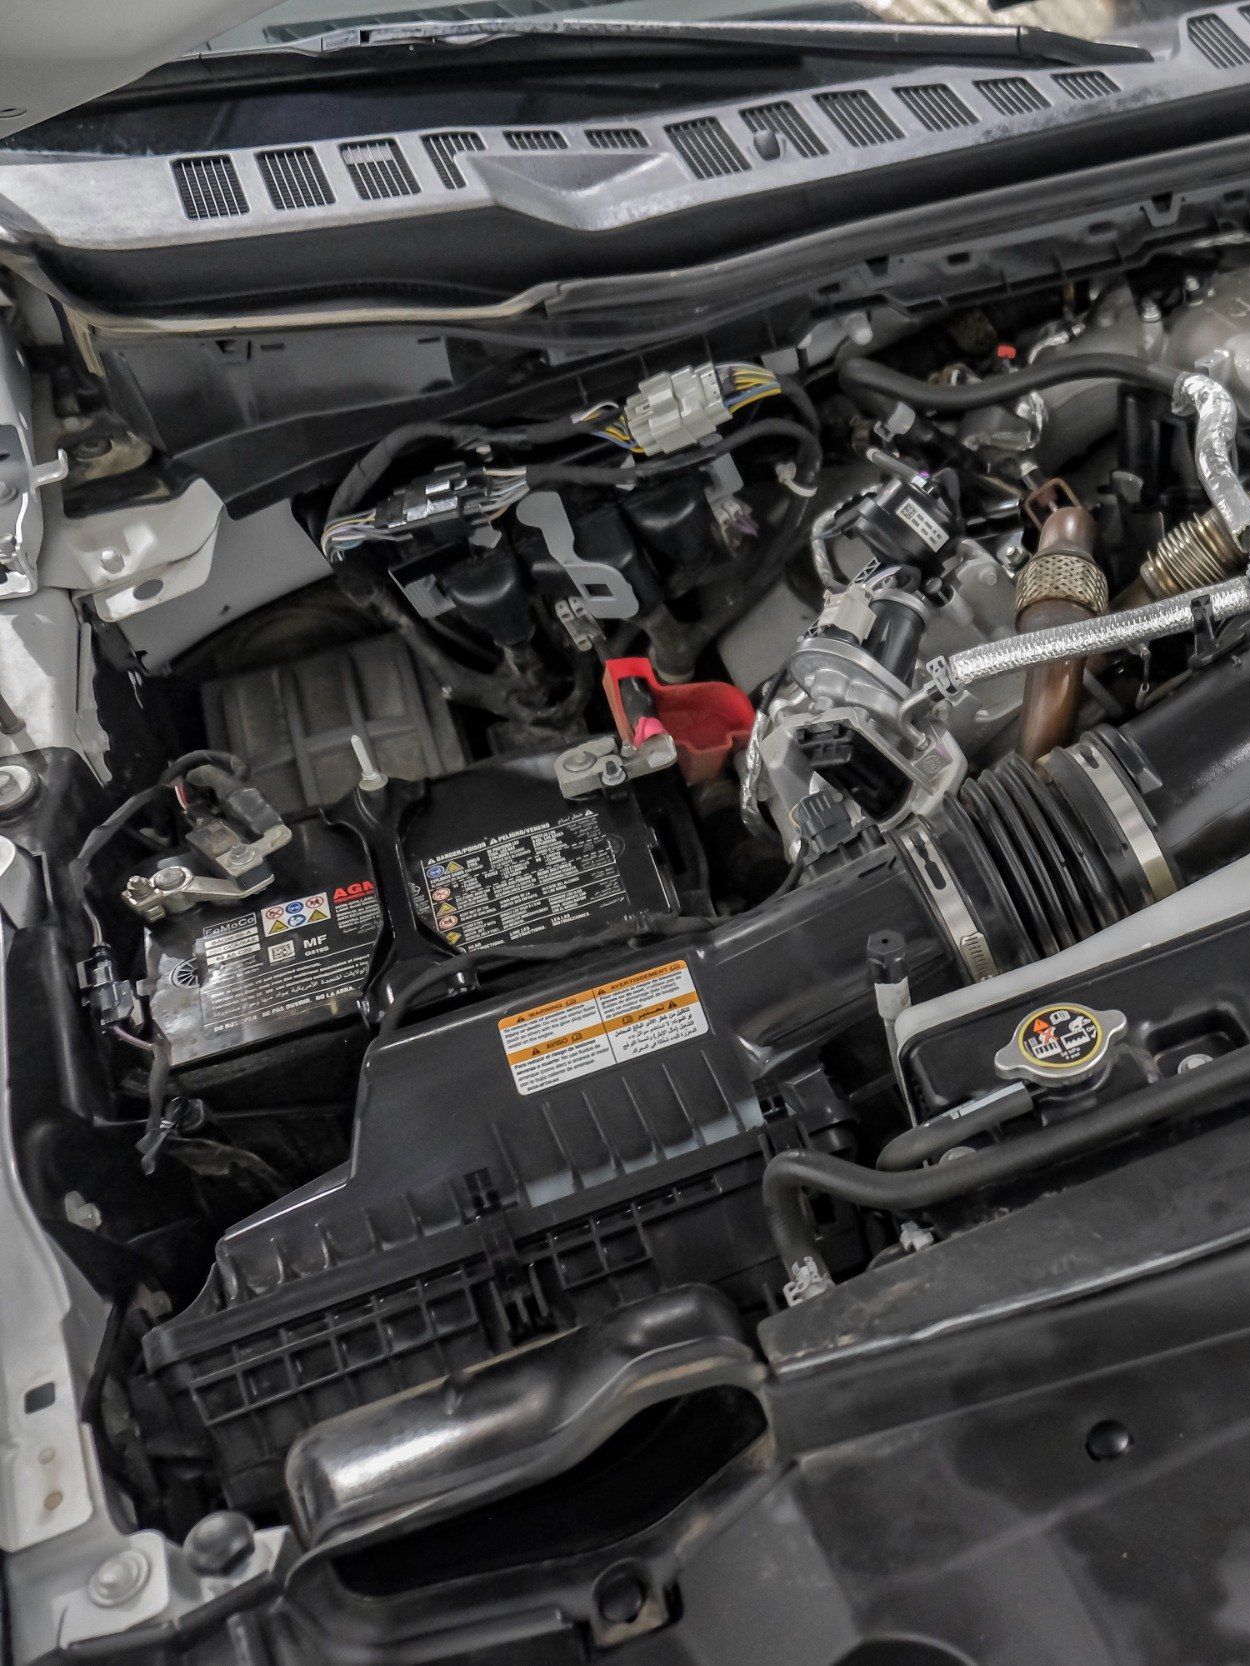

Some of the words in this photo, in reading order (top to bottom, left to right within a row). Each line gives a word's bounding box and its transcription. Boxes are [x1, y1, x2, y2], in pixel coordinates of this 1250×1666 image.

[206, 916, 254, 936] FoMoCo
[303, 933, 327, 949] MF
[610, 967, 667, 990] AVERTISSEMENT
[528, 1003, 563, 1018] WARNING
[546, 1037, 568, 1049] AVISO
